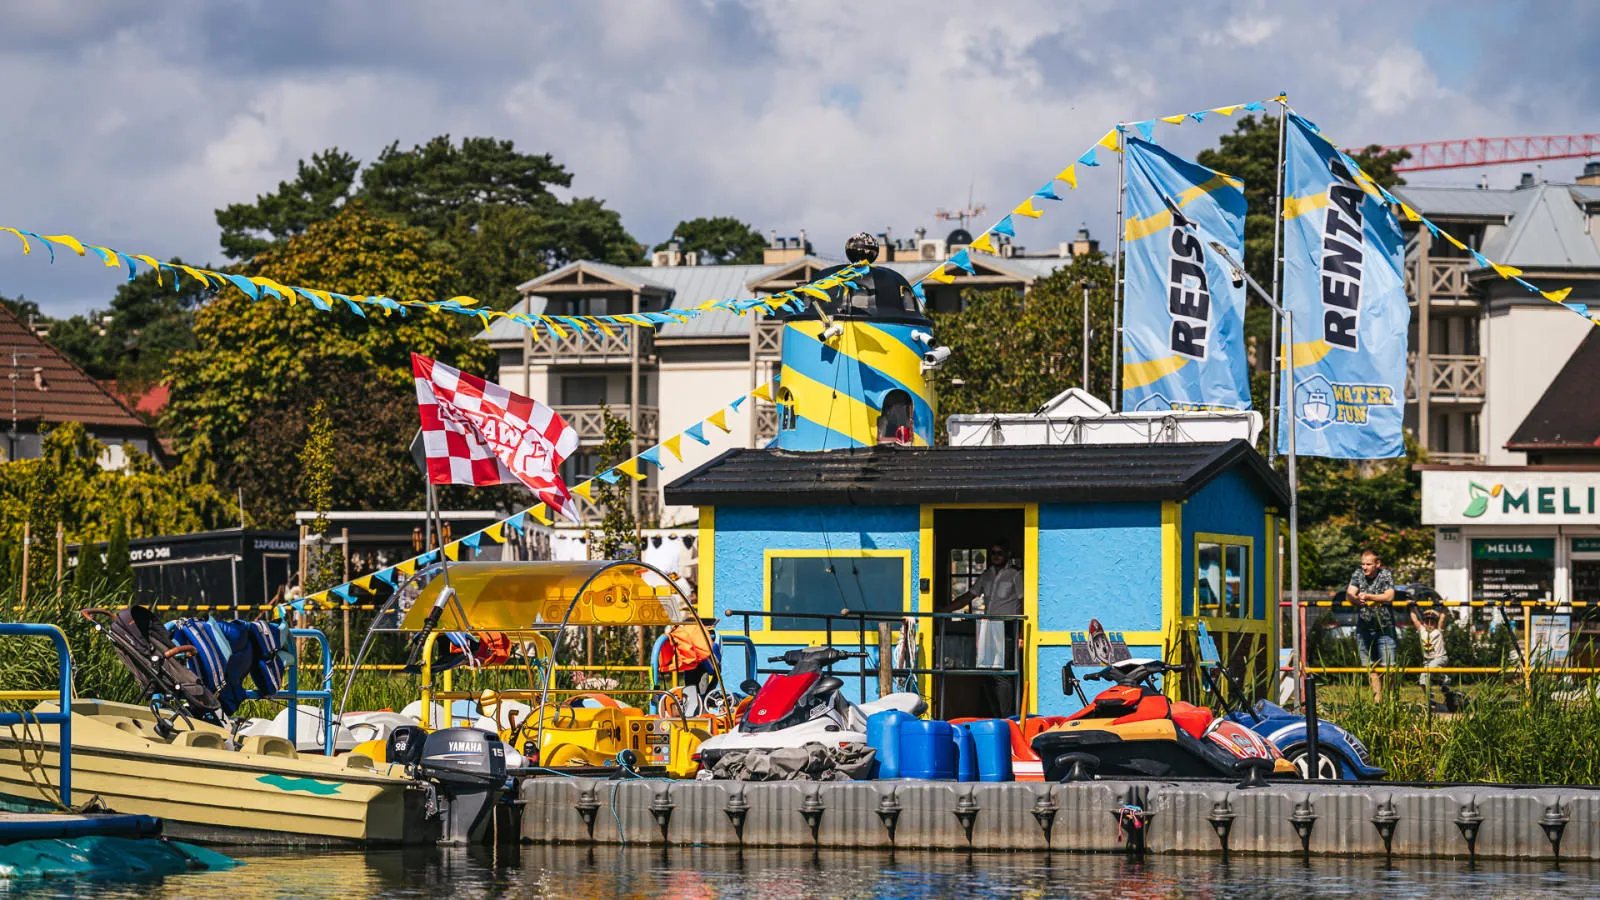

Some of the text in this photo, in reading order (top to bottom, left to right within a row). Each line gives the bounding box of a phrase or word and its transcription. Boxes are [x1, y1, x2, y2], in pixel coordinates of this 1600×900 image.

[1333, 384, 1393, 406] WATER
[1336, 404, 1368, 423] FUN
[1502, 486, 1596, 514] MELI
[1487, 543, 1534, 553] MELISA
[448, 741, 483, 753] YAMAHA
[491, 747, 504, 757] 15
